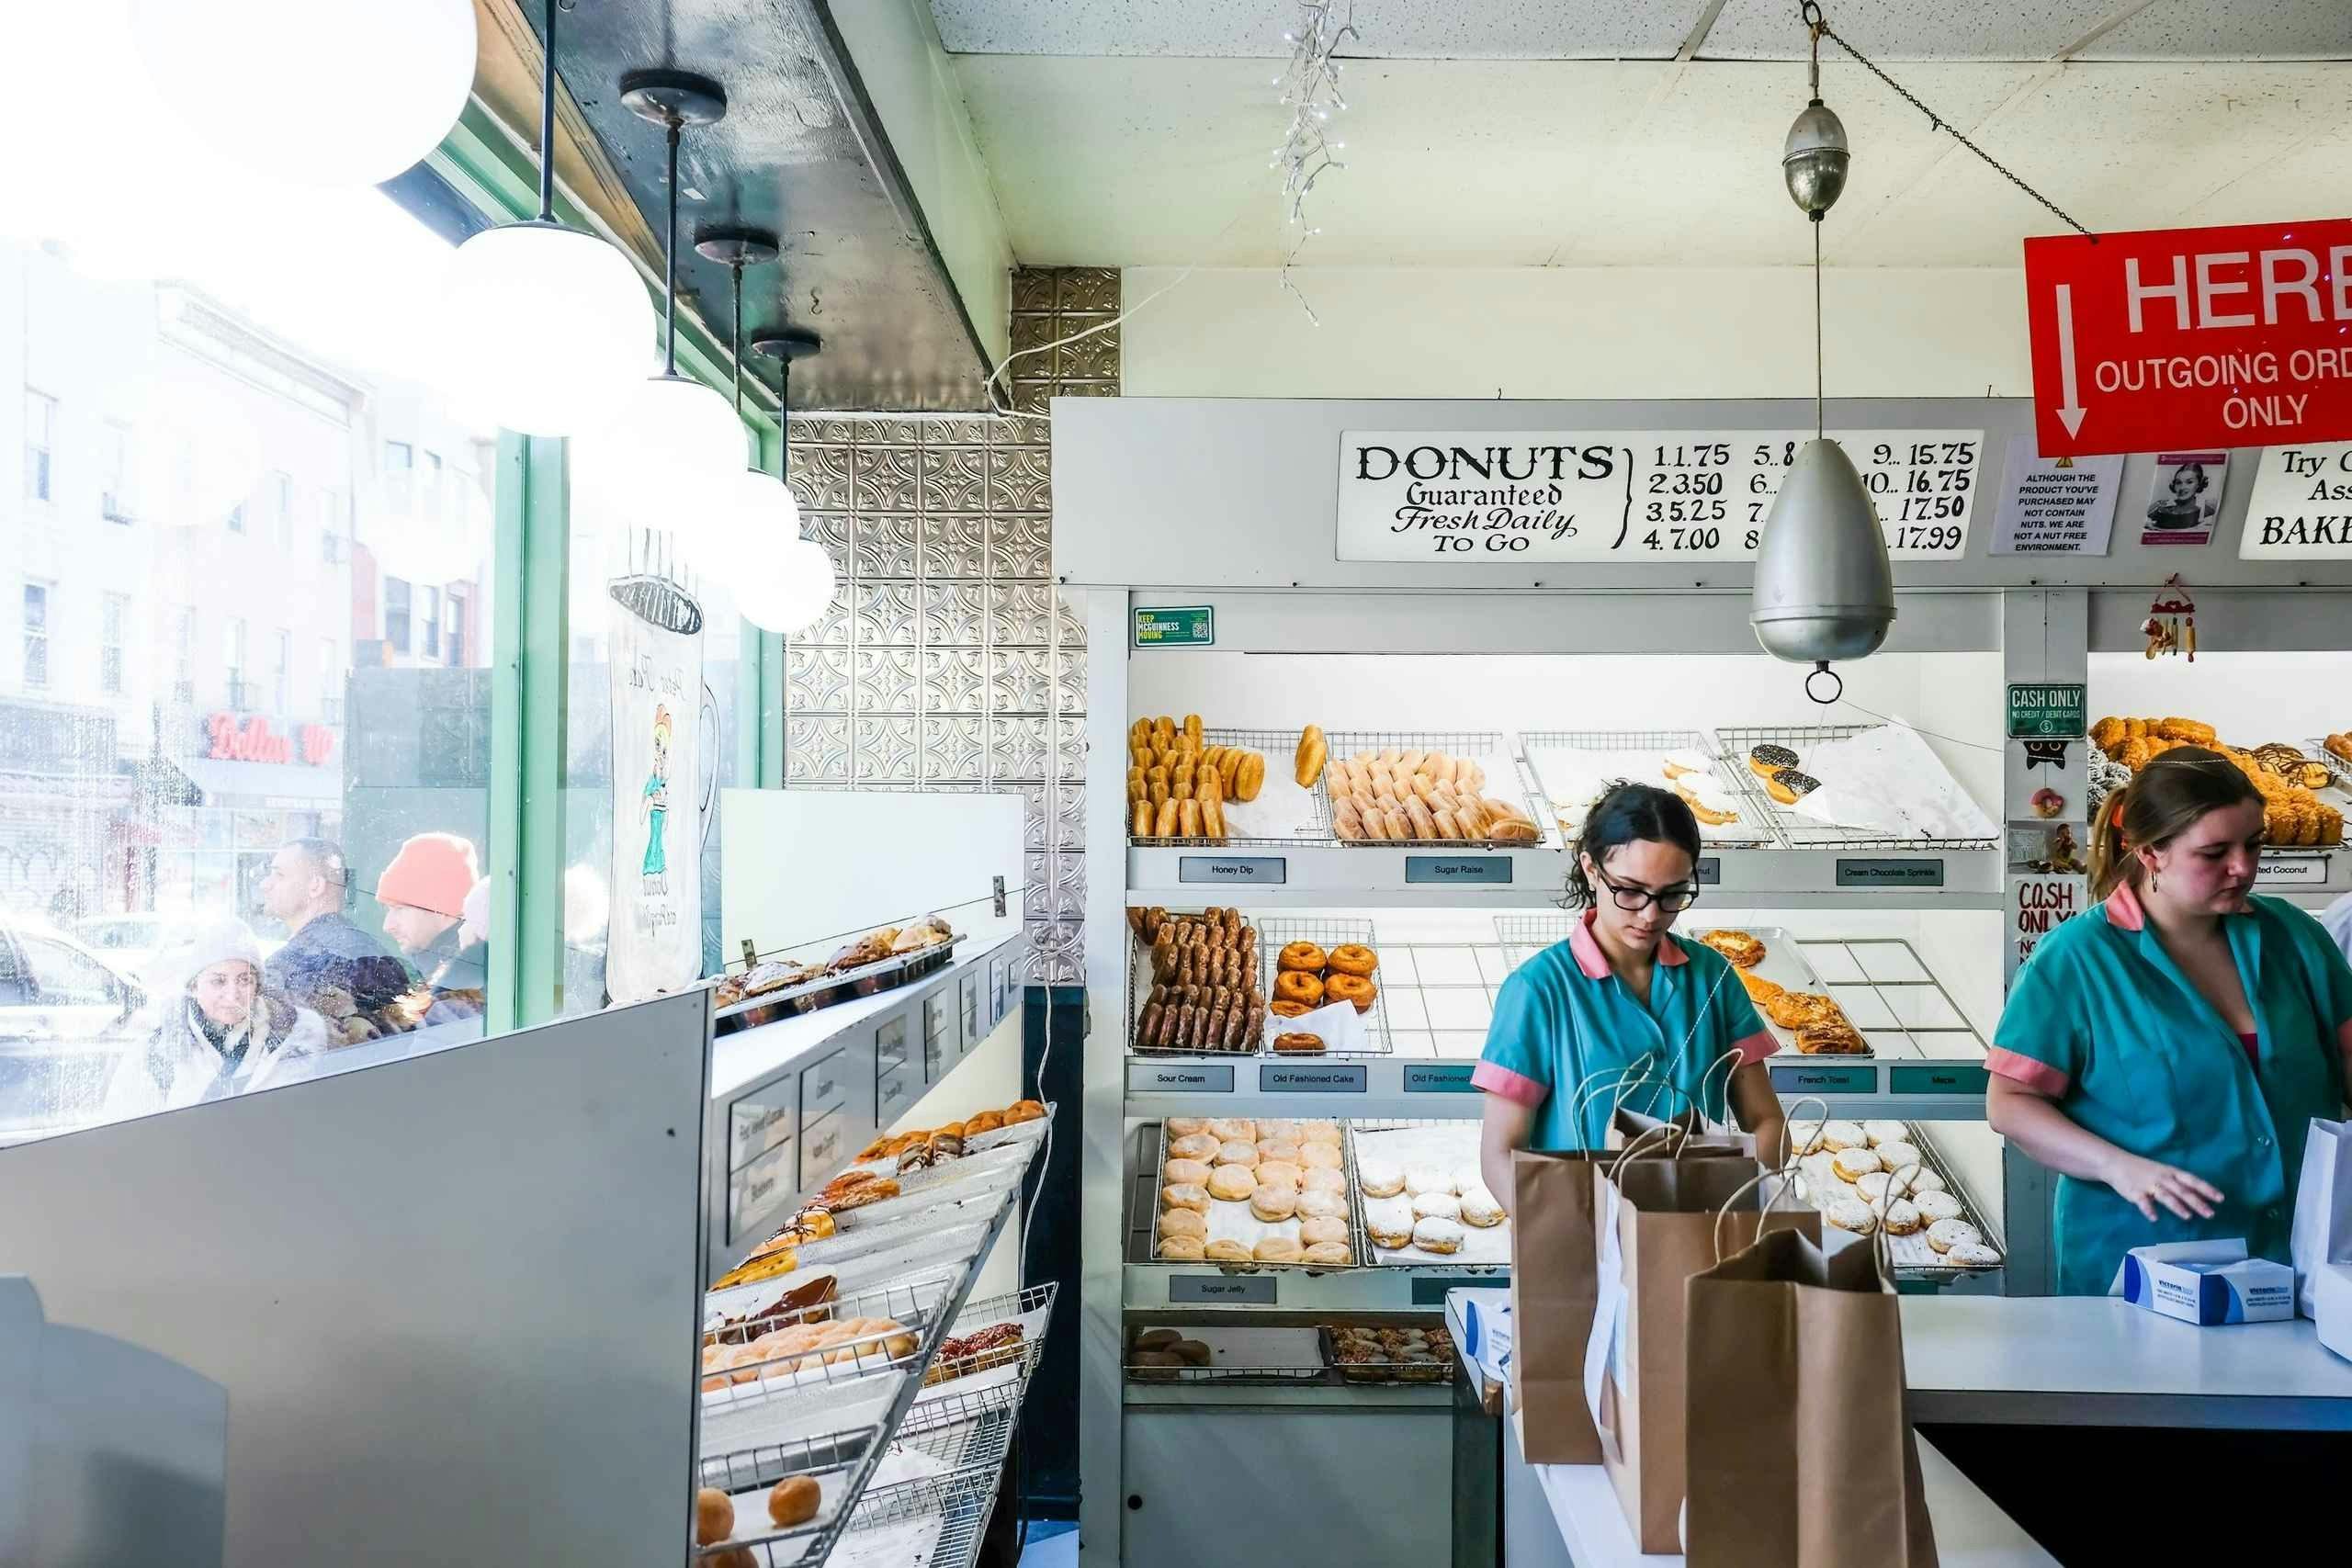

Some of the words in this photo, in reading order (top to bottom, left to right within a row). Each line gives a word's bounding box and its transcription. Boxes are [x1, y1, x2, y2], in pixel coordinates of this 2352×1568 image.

[2095, 353, 2278, 393] OUTGOING
[2222, 394, 2309, 430] ONLY
[1908, 442, 1977, 466] 15.75
[1355, 446, 1614, 480] DONUTS
[2281, 451, 2328, 479] Try
[1905, 468, 1973, 493] 16.75
[2025, 474, 2075, 483] ALTHOUGH
[2078, 474, 2097, 482] THE
[1406, 481, 1563, 506] Guaranteed
[2018, 486, 2064, 494] PRODUCT
[2065, 485, 2099, 494] YOU'VE
[2018, 497, 2075, 506] PURCHASED
[2076, 497, 2097, 505] MAY
[1898, 495, 1965, 521] 17.50
[2024, 509, 2044, 517] NOT
[2045, 509, 2086, 517] CONTAIN
[1390, 505, 1479, 533] Fresh
[1482, 507, 1578, 540] Daily
[2049, 520, 2064, 528] WE
[2065, 520, 2085, 528] ARE
[2014, 532, 2032, 540] NOT
[2034, 532, 2041, 540] A
[2043, 532, 2063, 540] NUT
[2064, 532, 2087, 540] FREE
[1432, 535, 1474, 552] TO
[1485, 534, 1530, 552] GO
[2015, 543, 2081, 552] ENVIRONMENT.
[2011, 690, 2046, 707] CASH
[2049, 690, 2081, 707] ONLY
[1212, 865, 1238, 875] Honey
[1239, 865, 1254, 875] Dip
[1434, 865, 1459, 875] Sugar
[1870, 867, 1905, 876] Chocolate
[2273, 865, 2308, 874] Coconut
[1157, 1074, 1177, 1082] Sour
[1178, 1074, 1205, 1083] Cream
[1272, 1074, 1287, 1082] Old
[1289, 1074, 1331, 1083] Fashioned
[1332, 1074, 1355, 1083] Cake
[1411, 1074, 1426, 1082] Old
[1428, 1074, 1471, 1082] Fashioned
[1798, 1075, 1826, 1084] French
[1201, 1284, 1226, 1294] Sugar
[1227, 1285, 1246, 1294] Jelly
